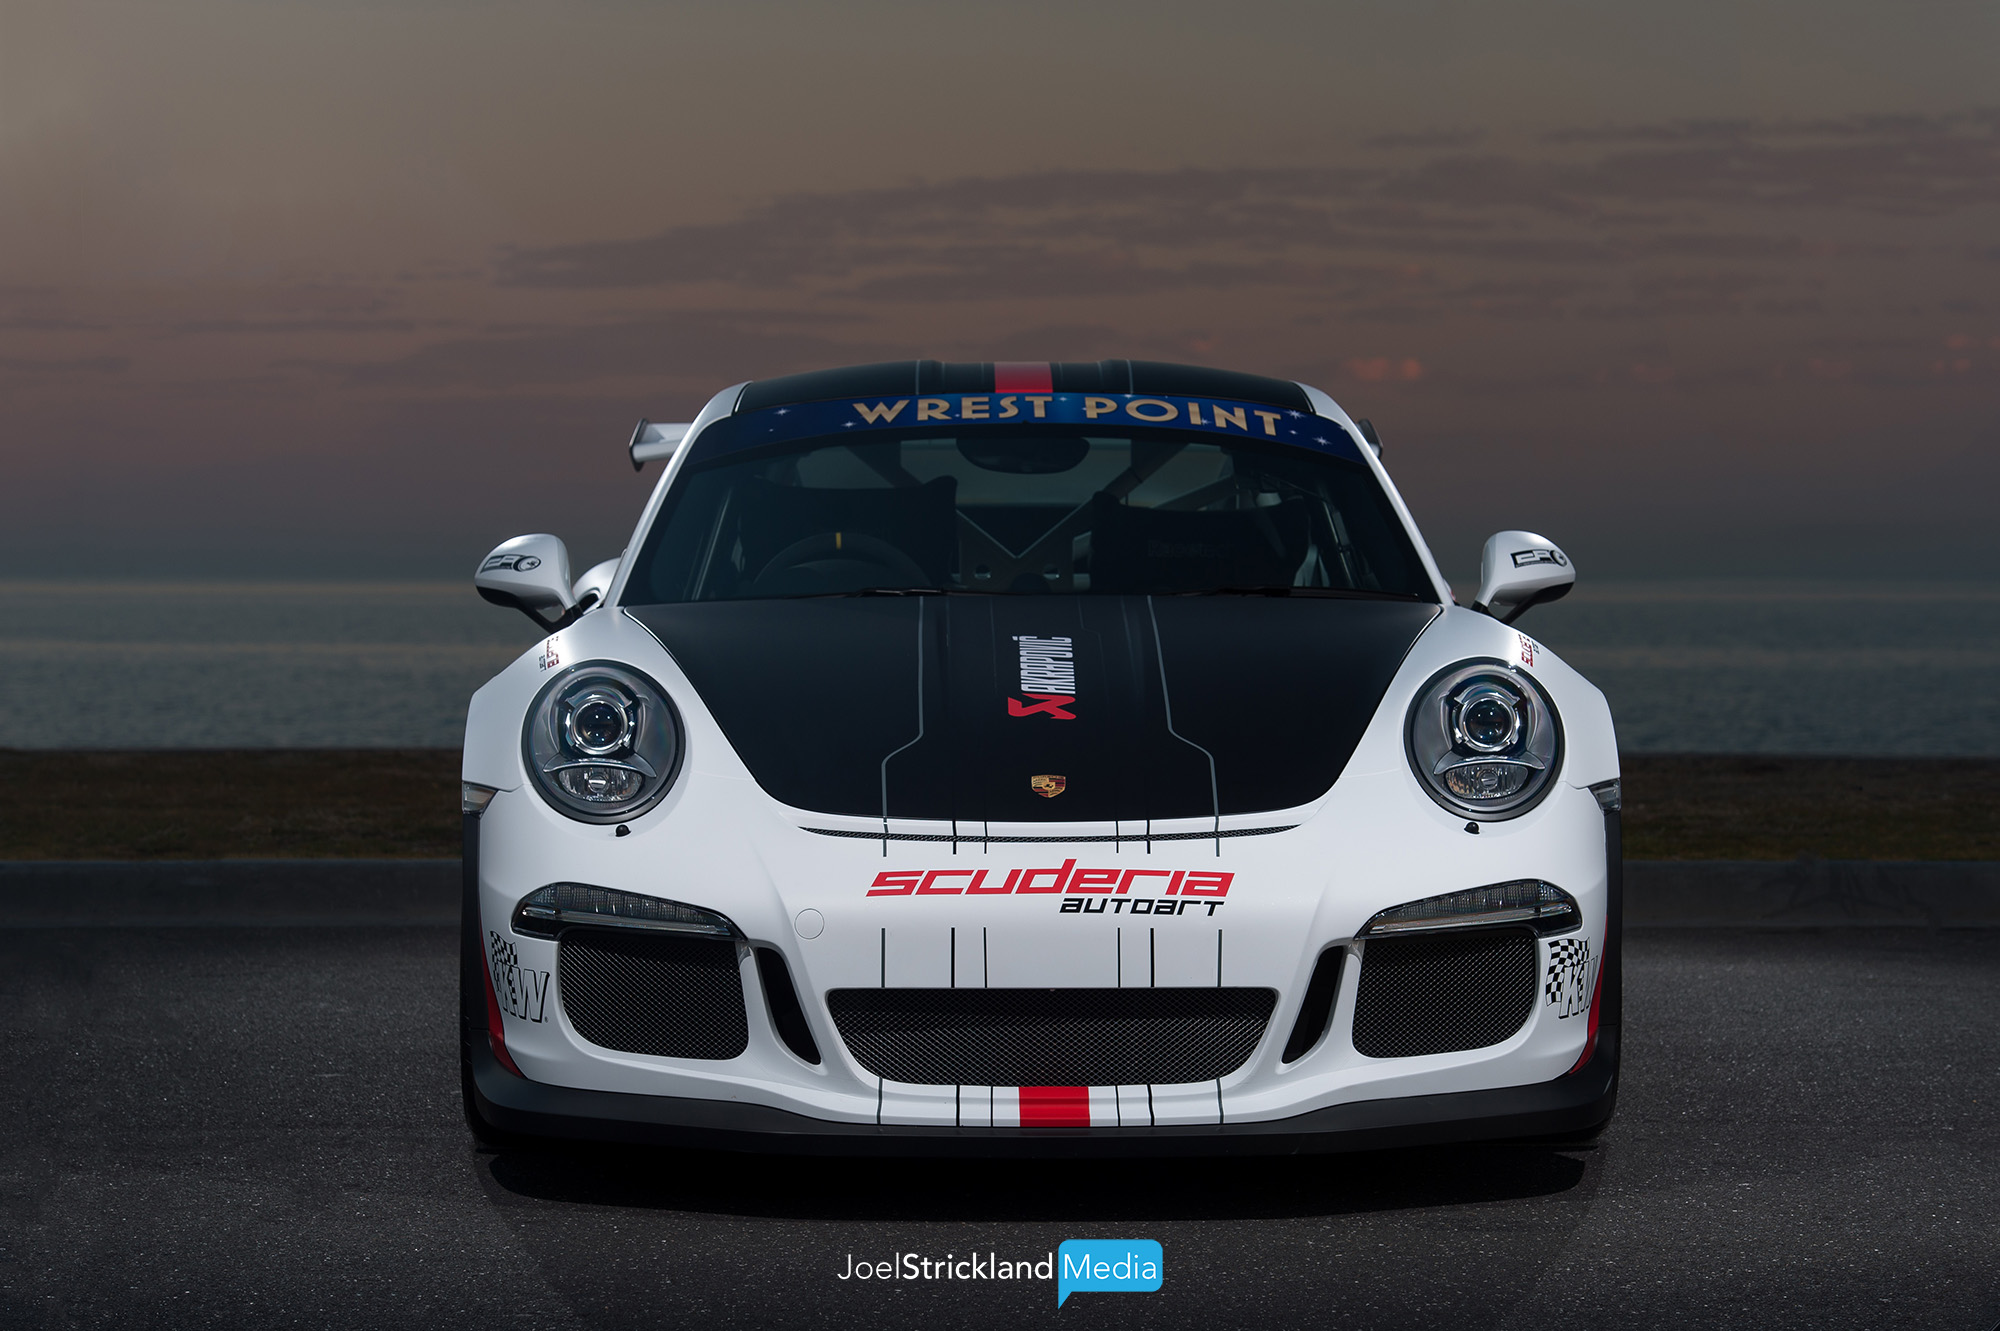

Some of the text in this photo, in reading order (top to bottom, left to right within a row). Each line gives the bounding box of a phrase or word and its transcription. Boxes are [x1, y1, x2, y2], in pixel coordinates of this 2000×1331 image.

[852, 395, 1282, 437] WREST POINT
[865, 858, 1236, 897] scuderia
